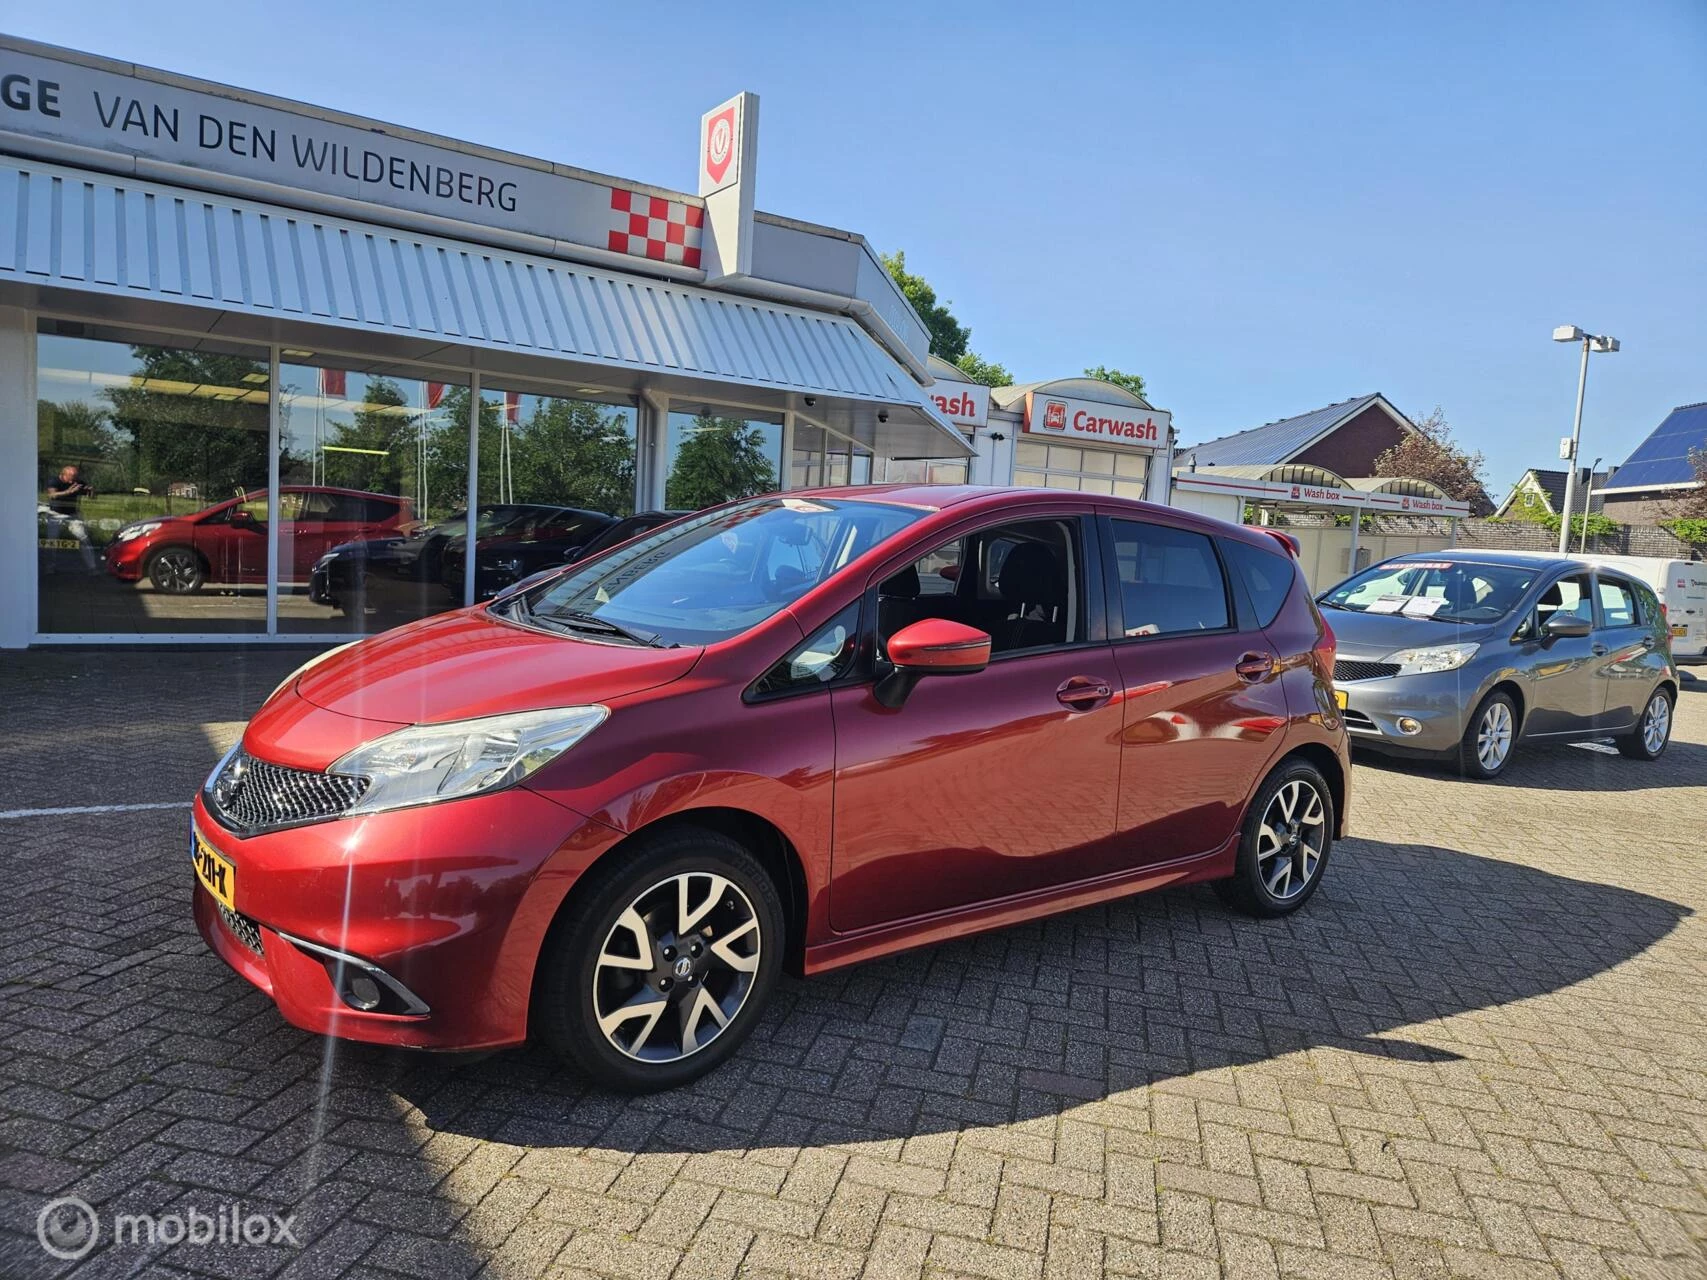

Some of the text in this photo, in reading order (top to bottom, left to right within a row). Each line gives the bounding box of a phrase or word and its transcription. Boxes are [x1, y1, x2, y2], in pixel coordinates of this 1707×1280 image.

[1, 74, 518, 212] GE VAN DEN WILDENBERG
[930, 391, 976, 418] ash
[1073, 410, 1158, 441] Carwash
[1304, 487, 1341, 501] Wash box
[1412, 499, 1444, 511] Wash box
